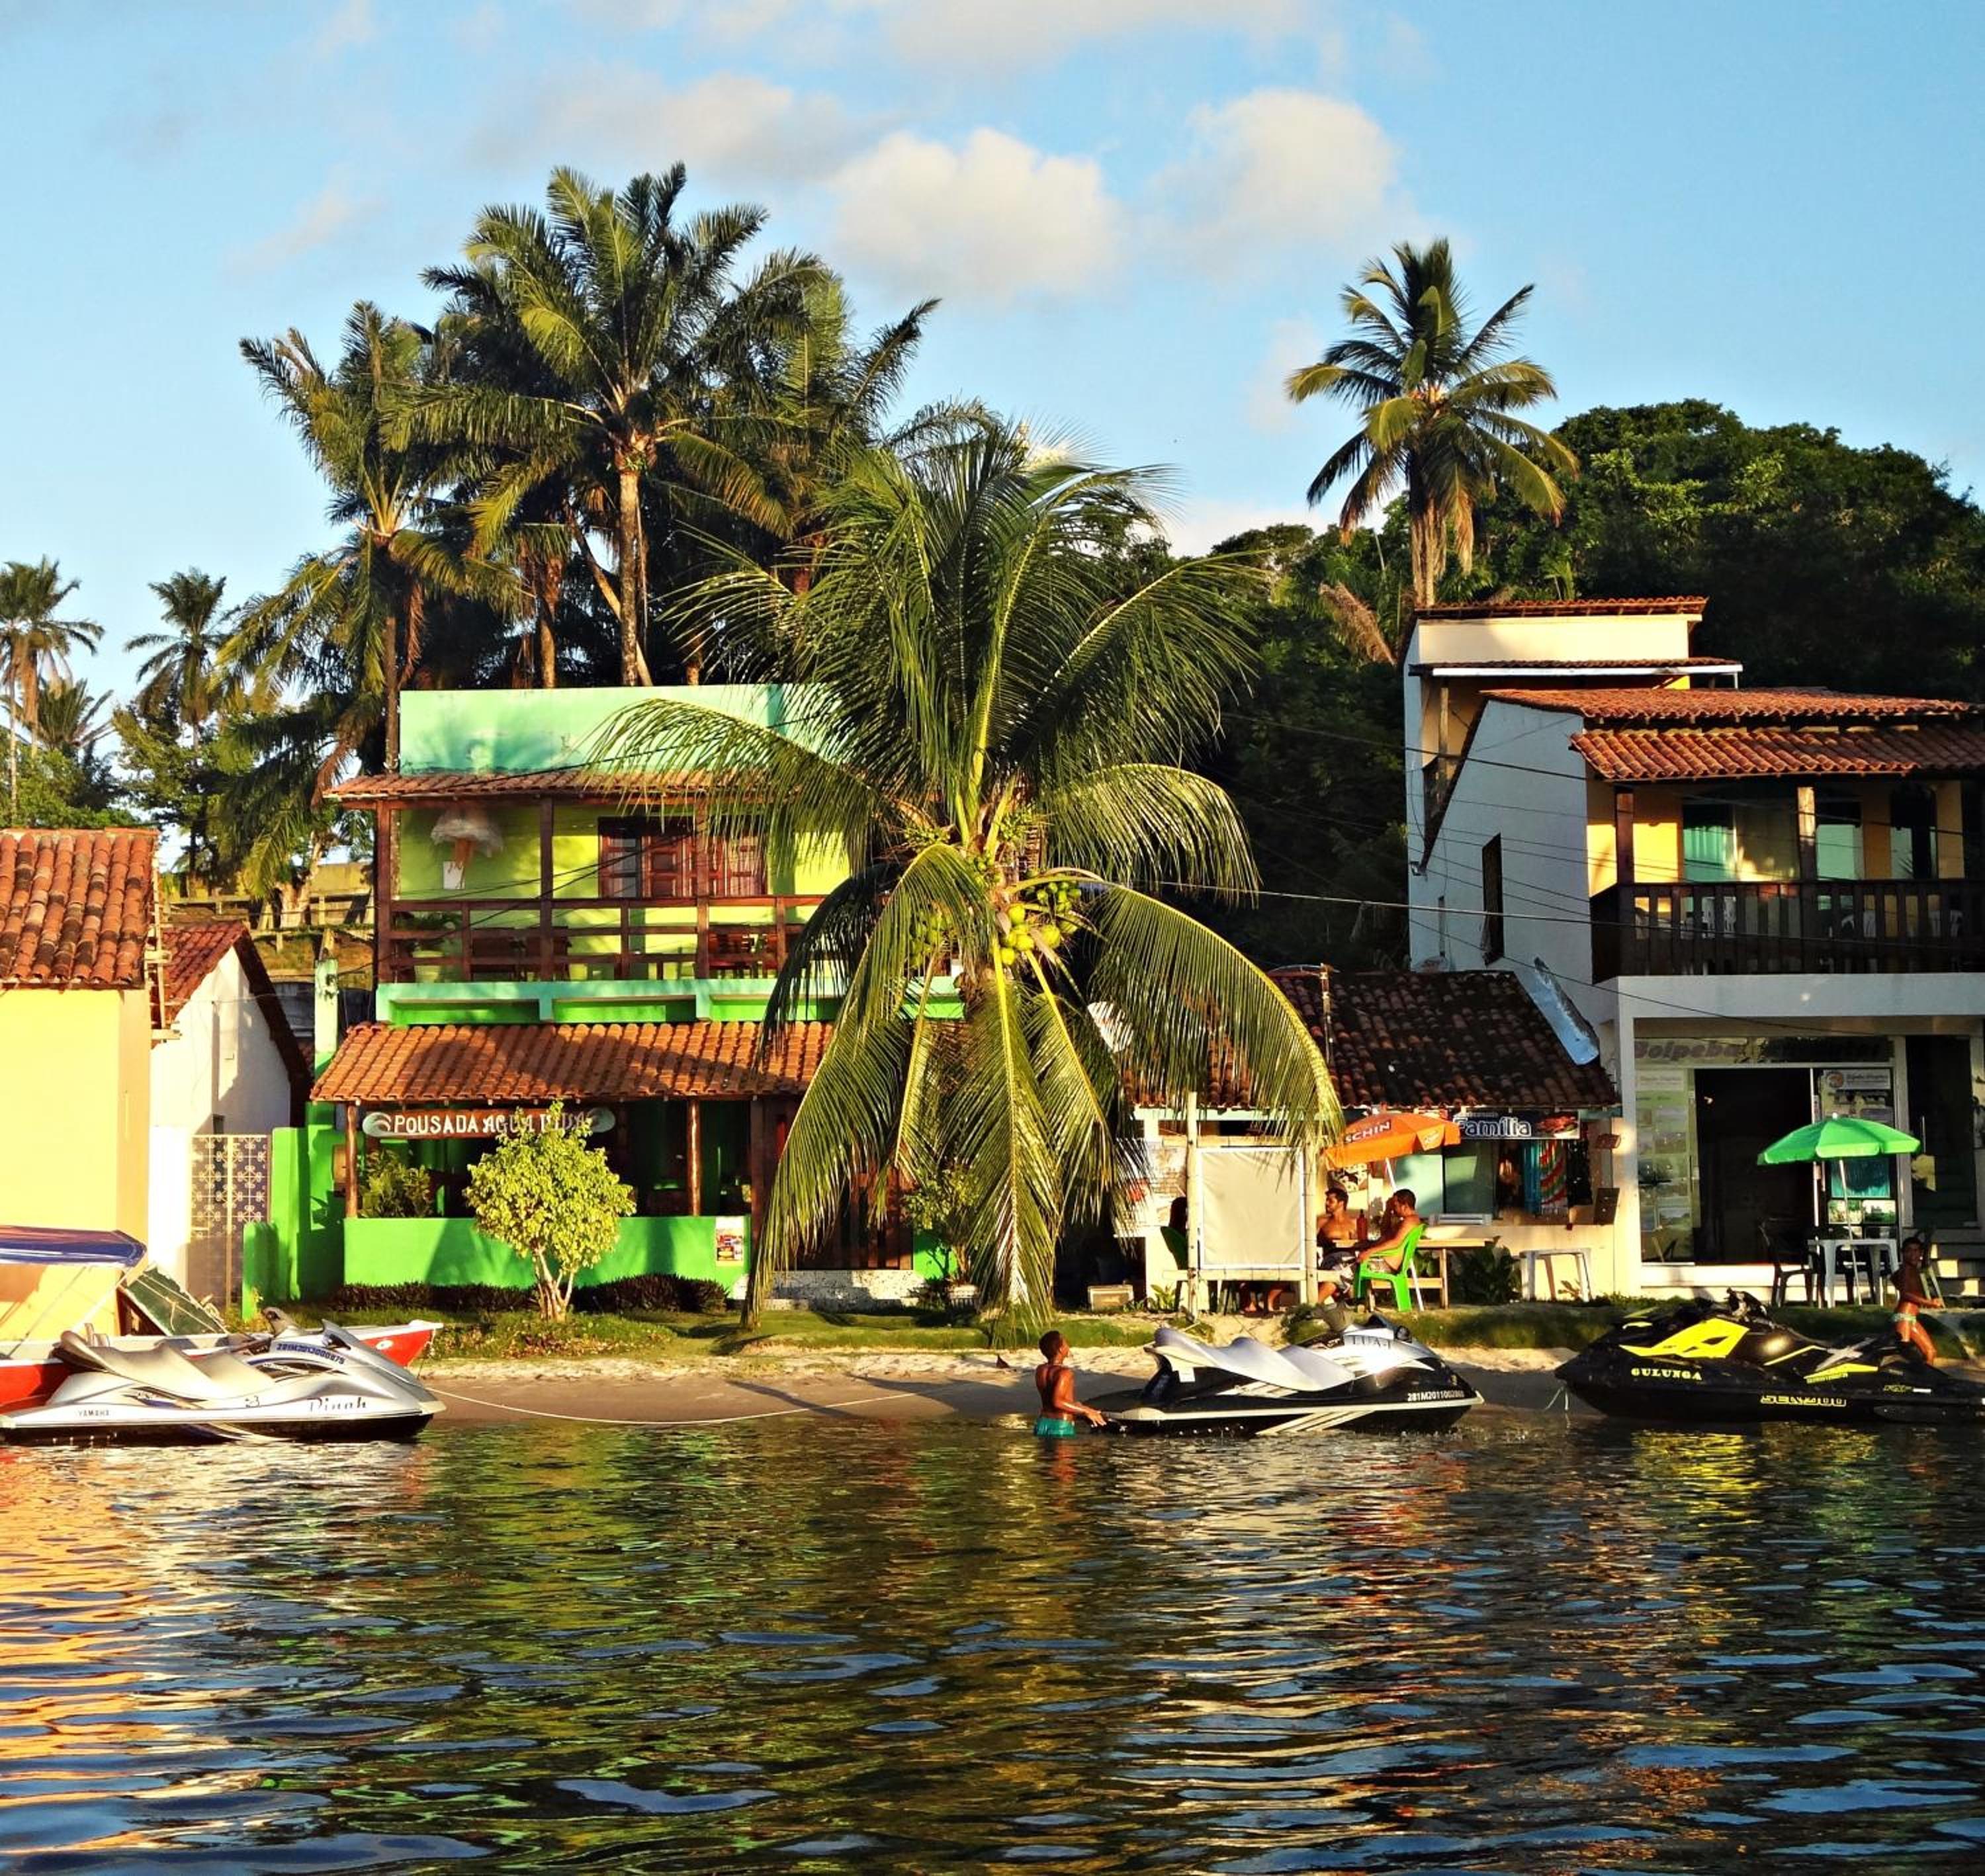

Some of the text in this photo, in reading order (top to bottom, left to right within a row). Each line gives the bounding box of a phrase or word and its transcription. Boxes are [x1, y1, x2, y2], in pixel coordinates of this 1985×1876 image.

[394, 1114, 478, 1134] POUSADA
[1345, 1121, 1390, 1144] SCHIN
[1453, 1117, 1532, 1136] Família
[1630, 1367, 1702, 1381] GULUNGA
